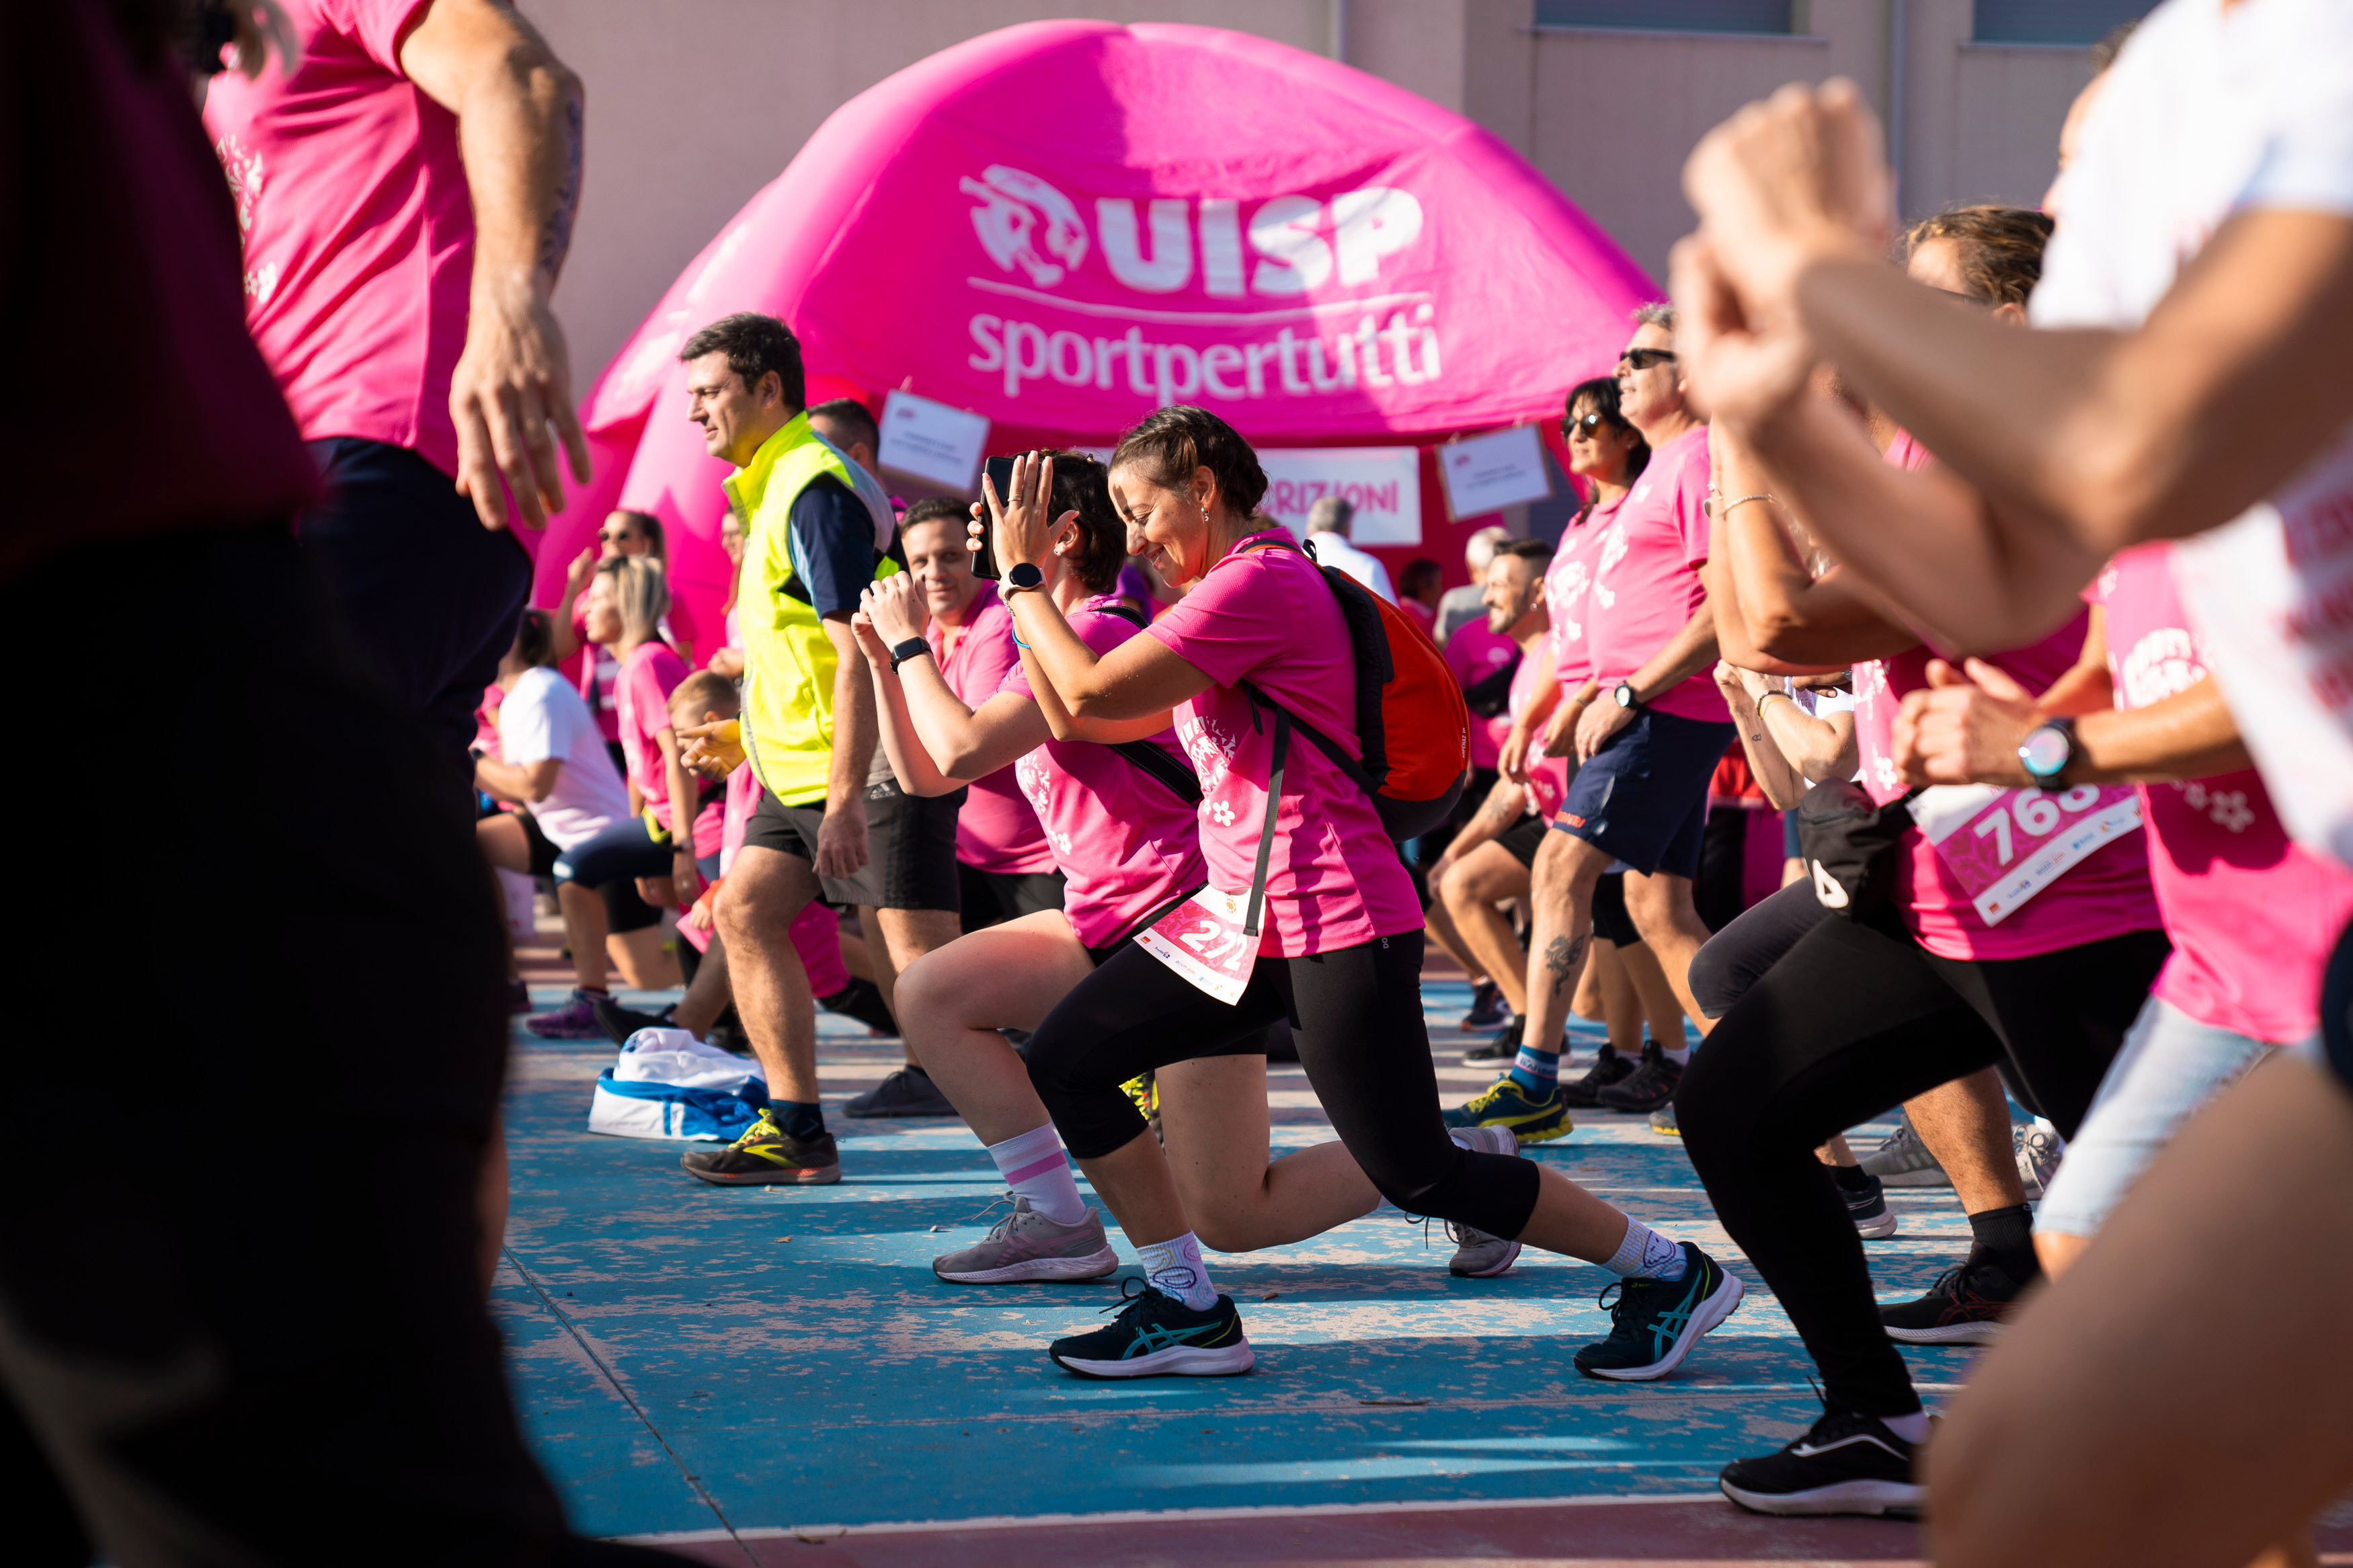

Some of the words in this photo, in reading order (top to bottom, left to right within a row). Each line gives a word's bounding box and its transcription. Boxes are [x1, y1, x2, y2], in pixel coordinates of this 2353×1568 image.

[1096, 186, 1423, 296] UISP
[969, 304, 1439, 405] sportpertutti
[1179, 920, 1248, 971] 272
